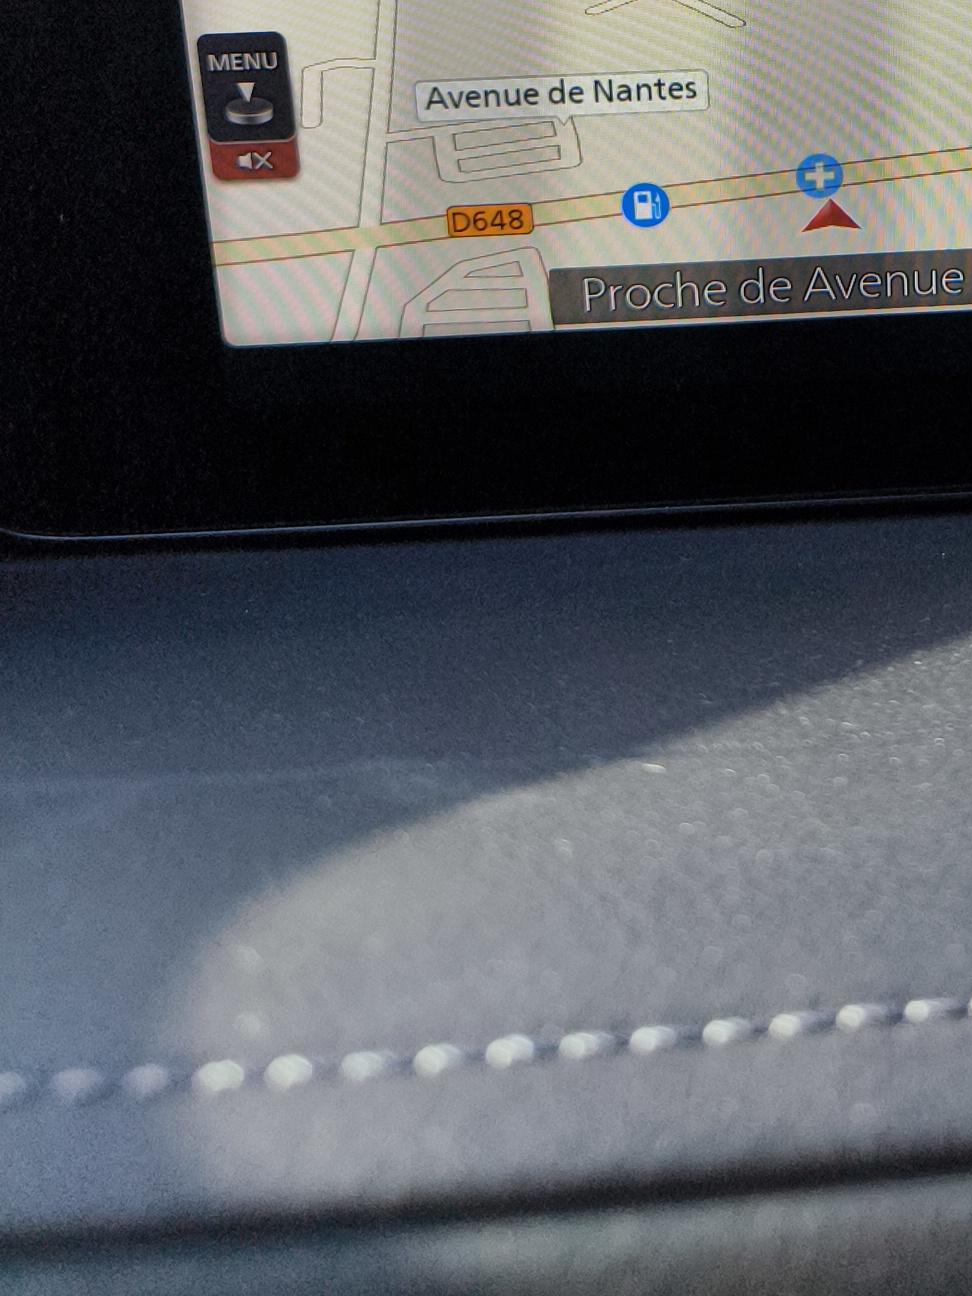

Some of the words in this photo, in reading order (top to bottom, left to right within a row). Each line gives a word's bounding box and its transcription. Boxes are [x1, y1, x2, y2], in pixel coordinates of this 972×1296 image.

[207, 52, 278, 71] MENU
[425, 85, 540, 111] Avenue
[548, 78, 585, 105] de
[593, 76, 698, 103] Nantes
[451, 208, 526, 234] D648
[583, 271, 728, 312] Proche
[738, 267, 793, 304] de
[803, 264, 964, 302] Avenue
